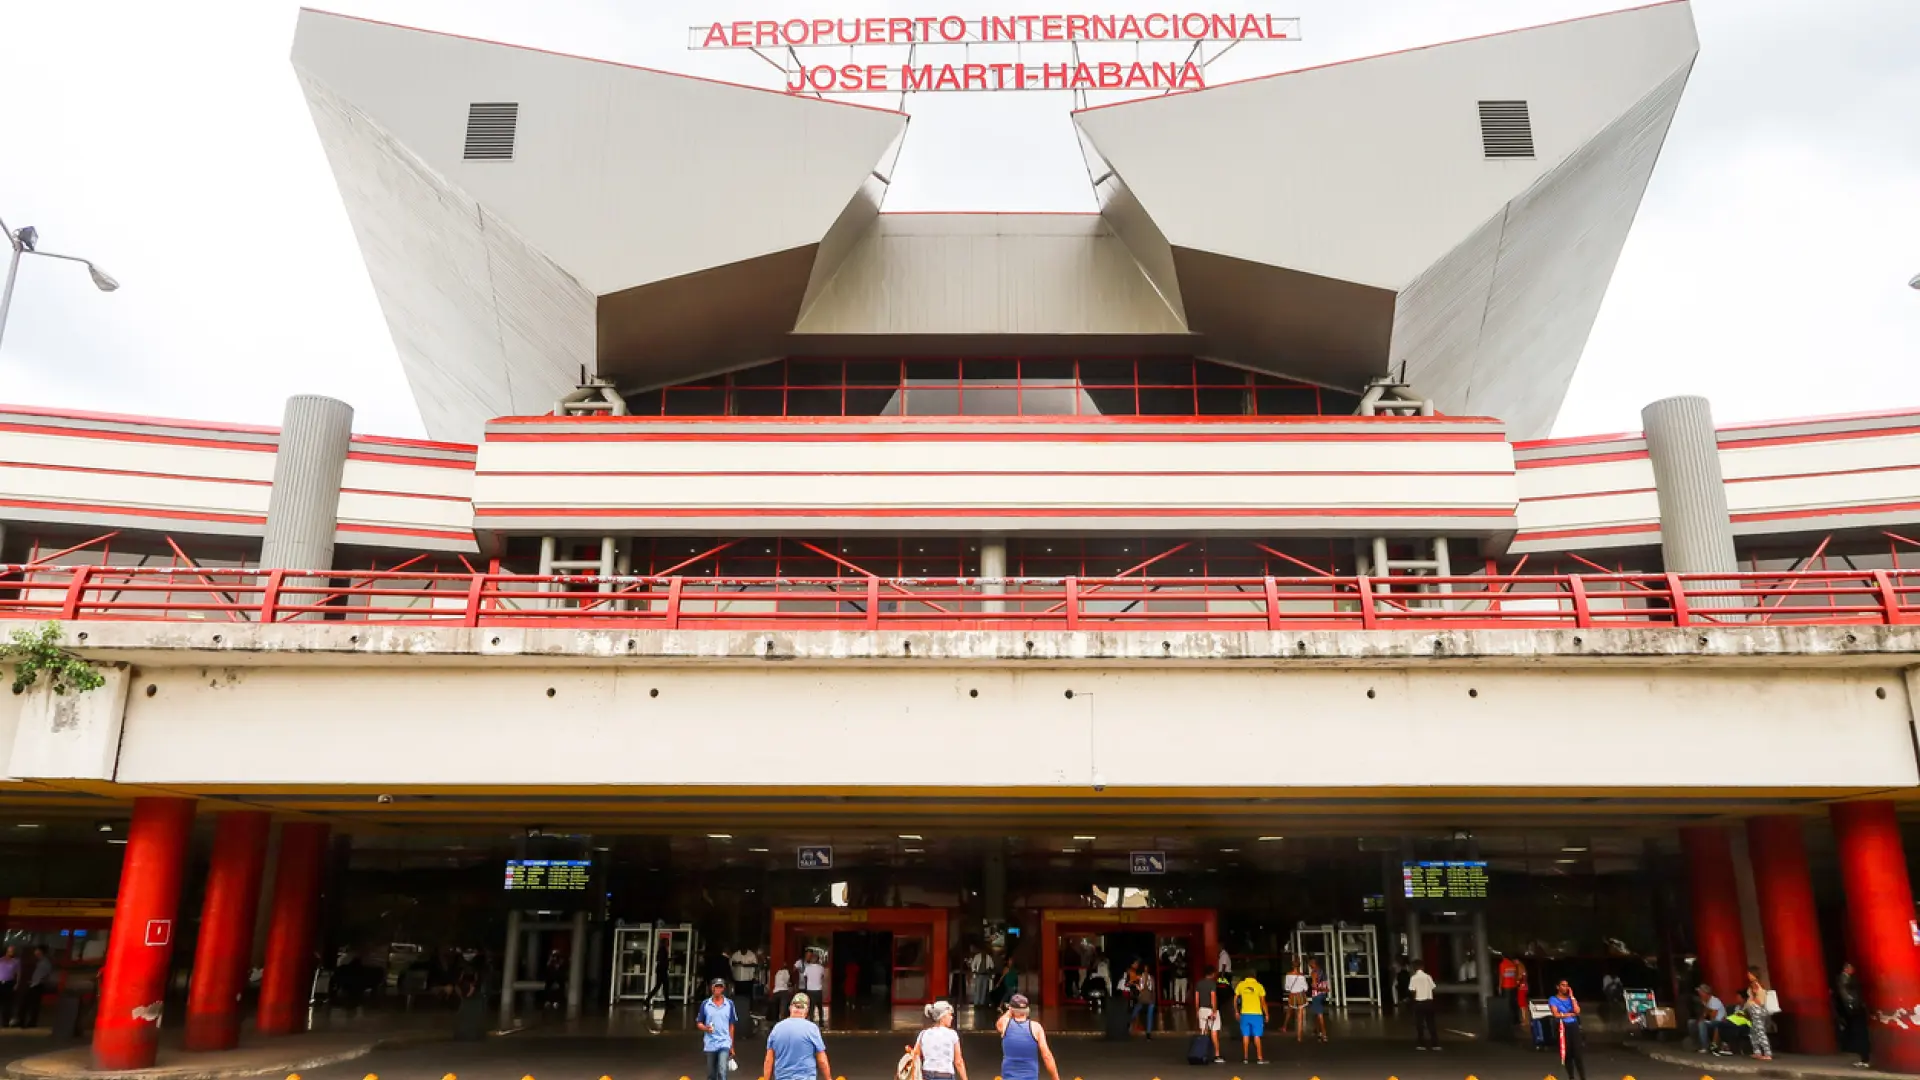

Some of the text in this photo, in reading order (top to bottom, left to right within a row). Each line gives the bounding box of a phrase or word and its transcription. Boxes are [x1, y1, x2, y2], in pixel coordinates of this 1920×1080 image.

[703, 12, 1287, 47] AEROPUERTO INTERNACIONAL
[787, 61, 1206, 92] JOSE MARTI-HABANA
